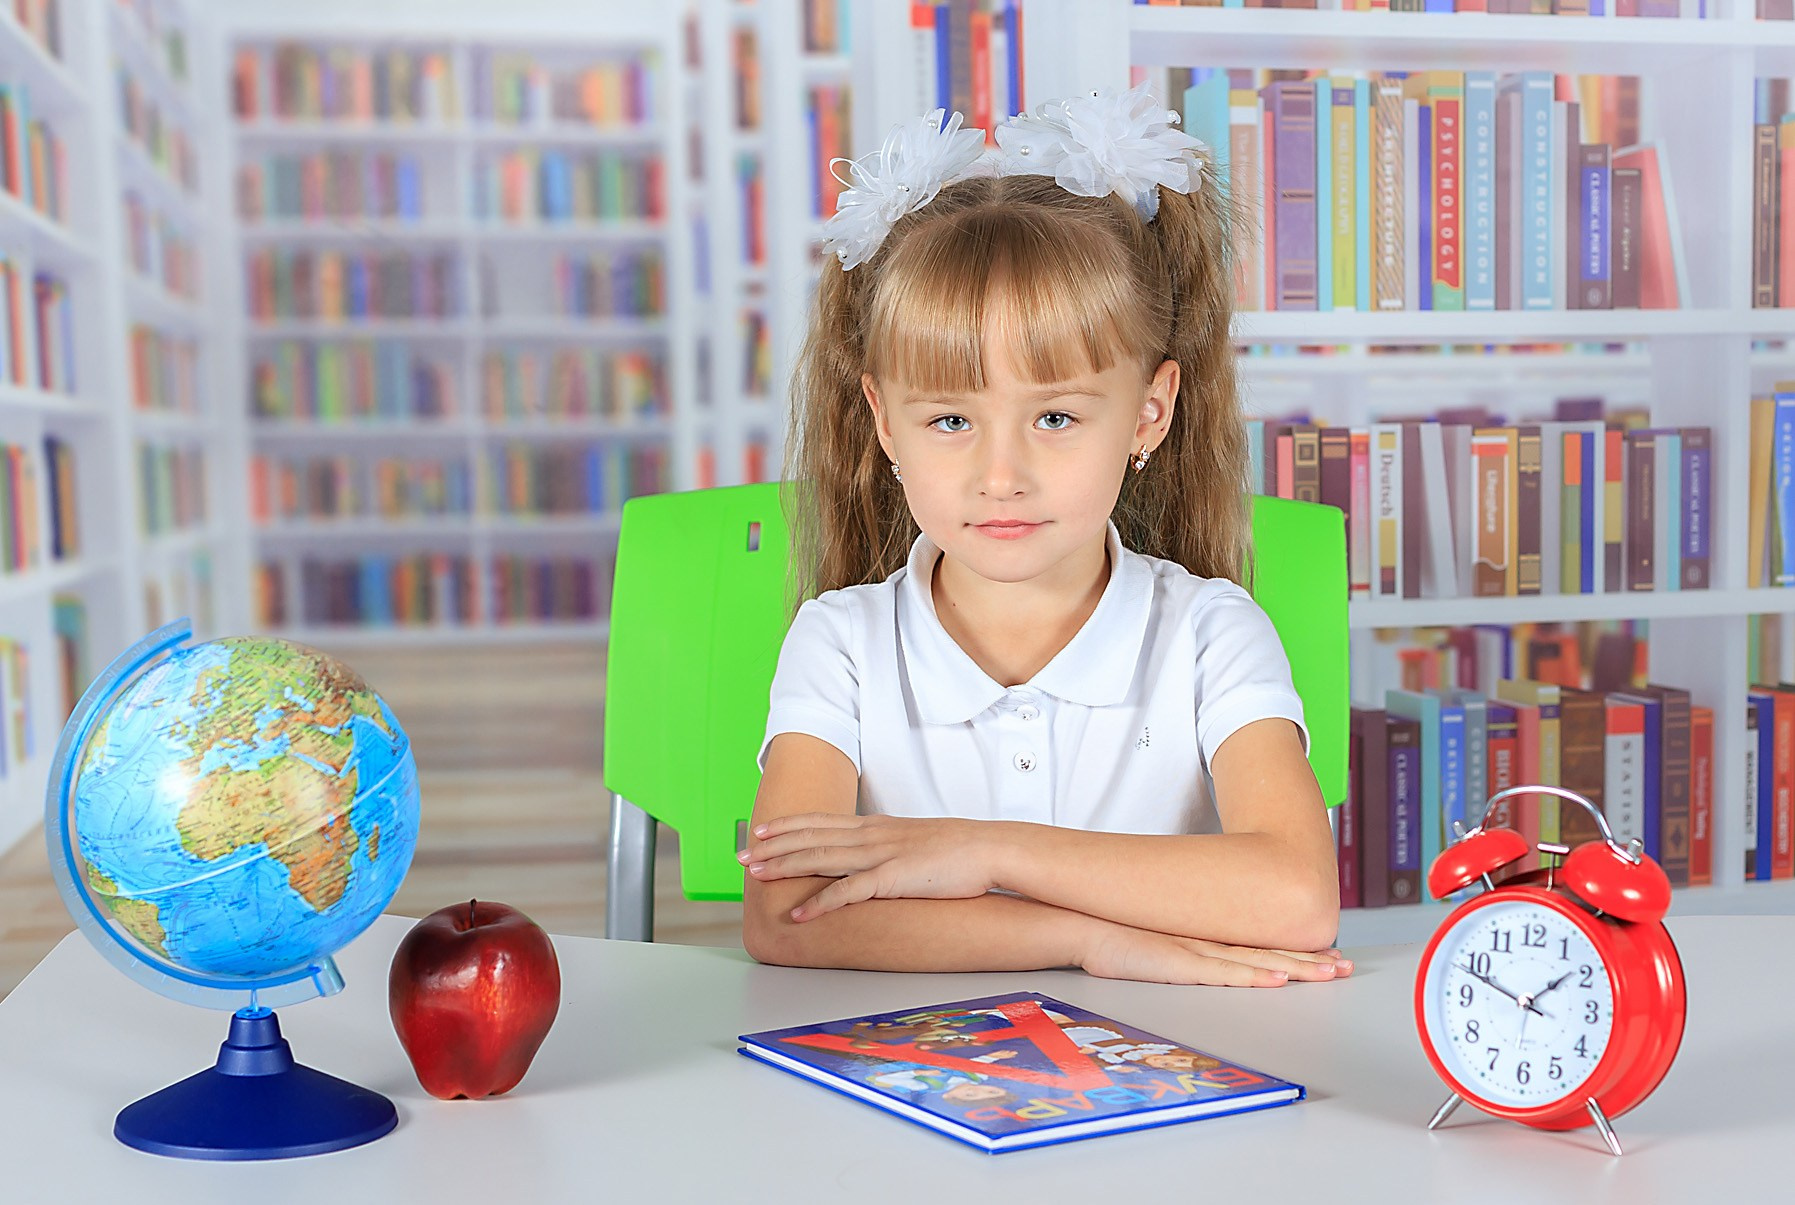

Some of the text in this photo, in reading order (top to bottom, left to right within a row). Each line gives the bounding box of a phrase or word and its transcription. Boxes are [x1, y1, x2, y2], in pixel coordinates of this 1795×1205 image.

[1440, 116, 1455, 271] PSYCHOLOGY
[1477, 110, 1489, 285] CONSTRUCTION
[1536, 110, 1547, 284] CONSTRUCTION
[1380, 454, 1394, 517] Deutsch
[1622, 741, 1632, 837] STATIST
[1489, 929, 1513, 954] 11
[1521, 922, 1548, 948] 12
[1559, 937, 1570, 961] 1
[1468, 952, 1491, 976] 10
[1579, 964, 1593, 988] 2
[1459, 984, 1474, 1008] 9
[1584, 1000, 1599, 1025] 3
[1464, 1019, 1480, 1044] 8
[1486, 1047, 1500, 1071] 7
[1574, 1034, 1589, 1059] 4
[1516, 1061, 1531, 1085] 6
[1549, 1056, 1563, 1080] 5
